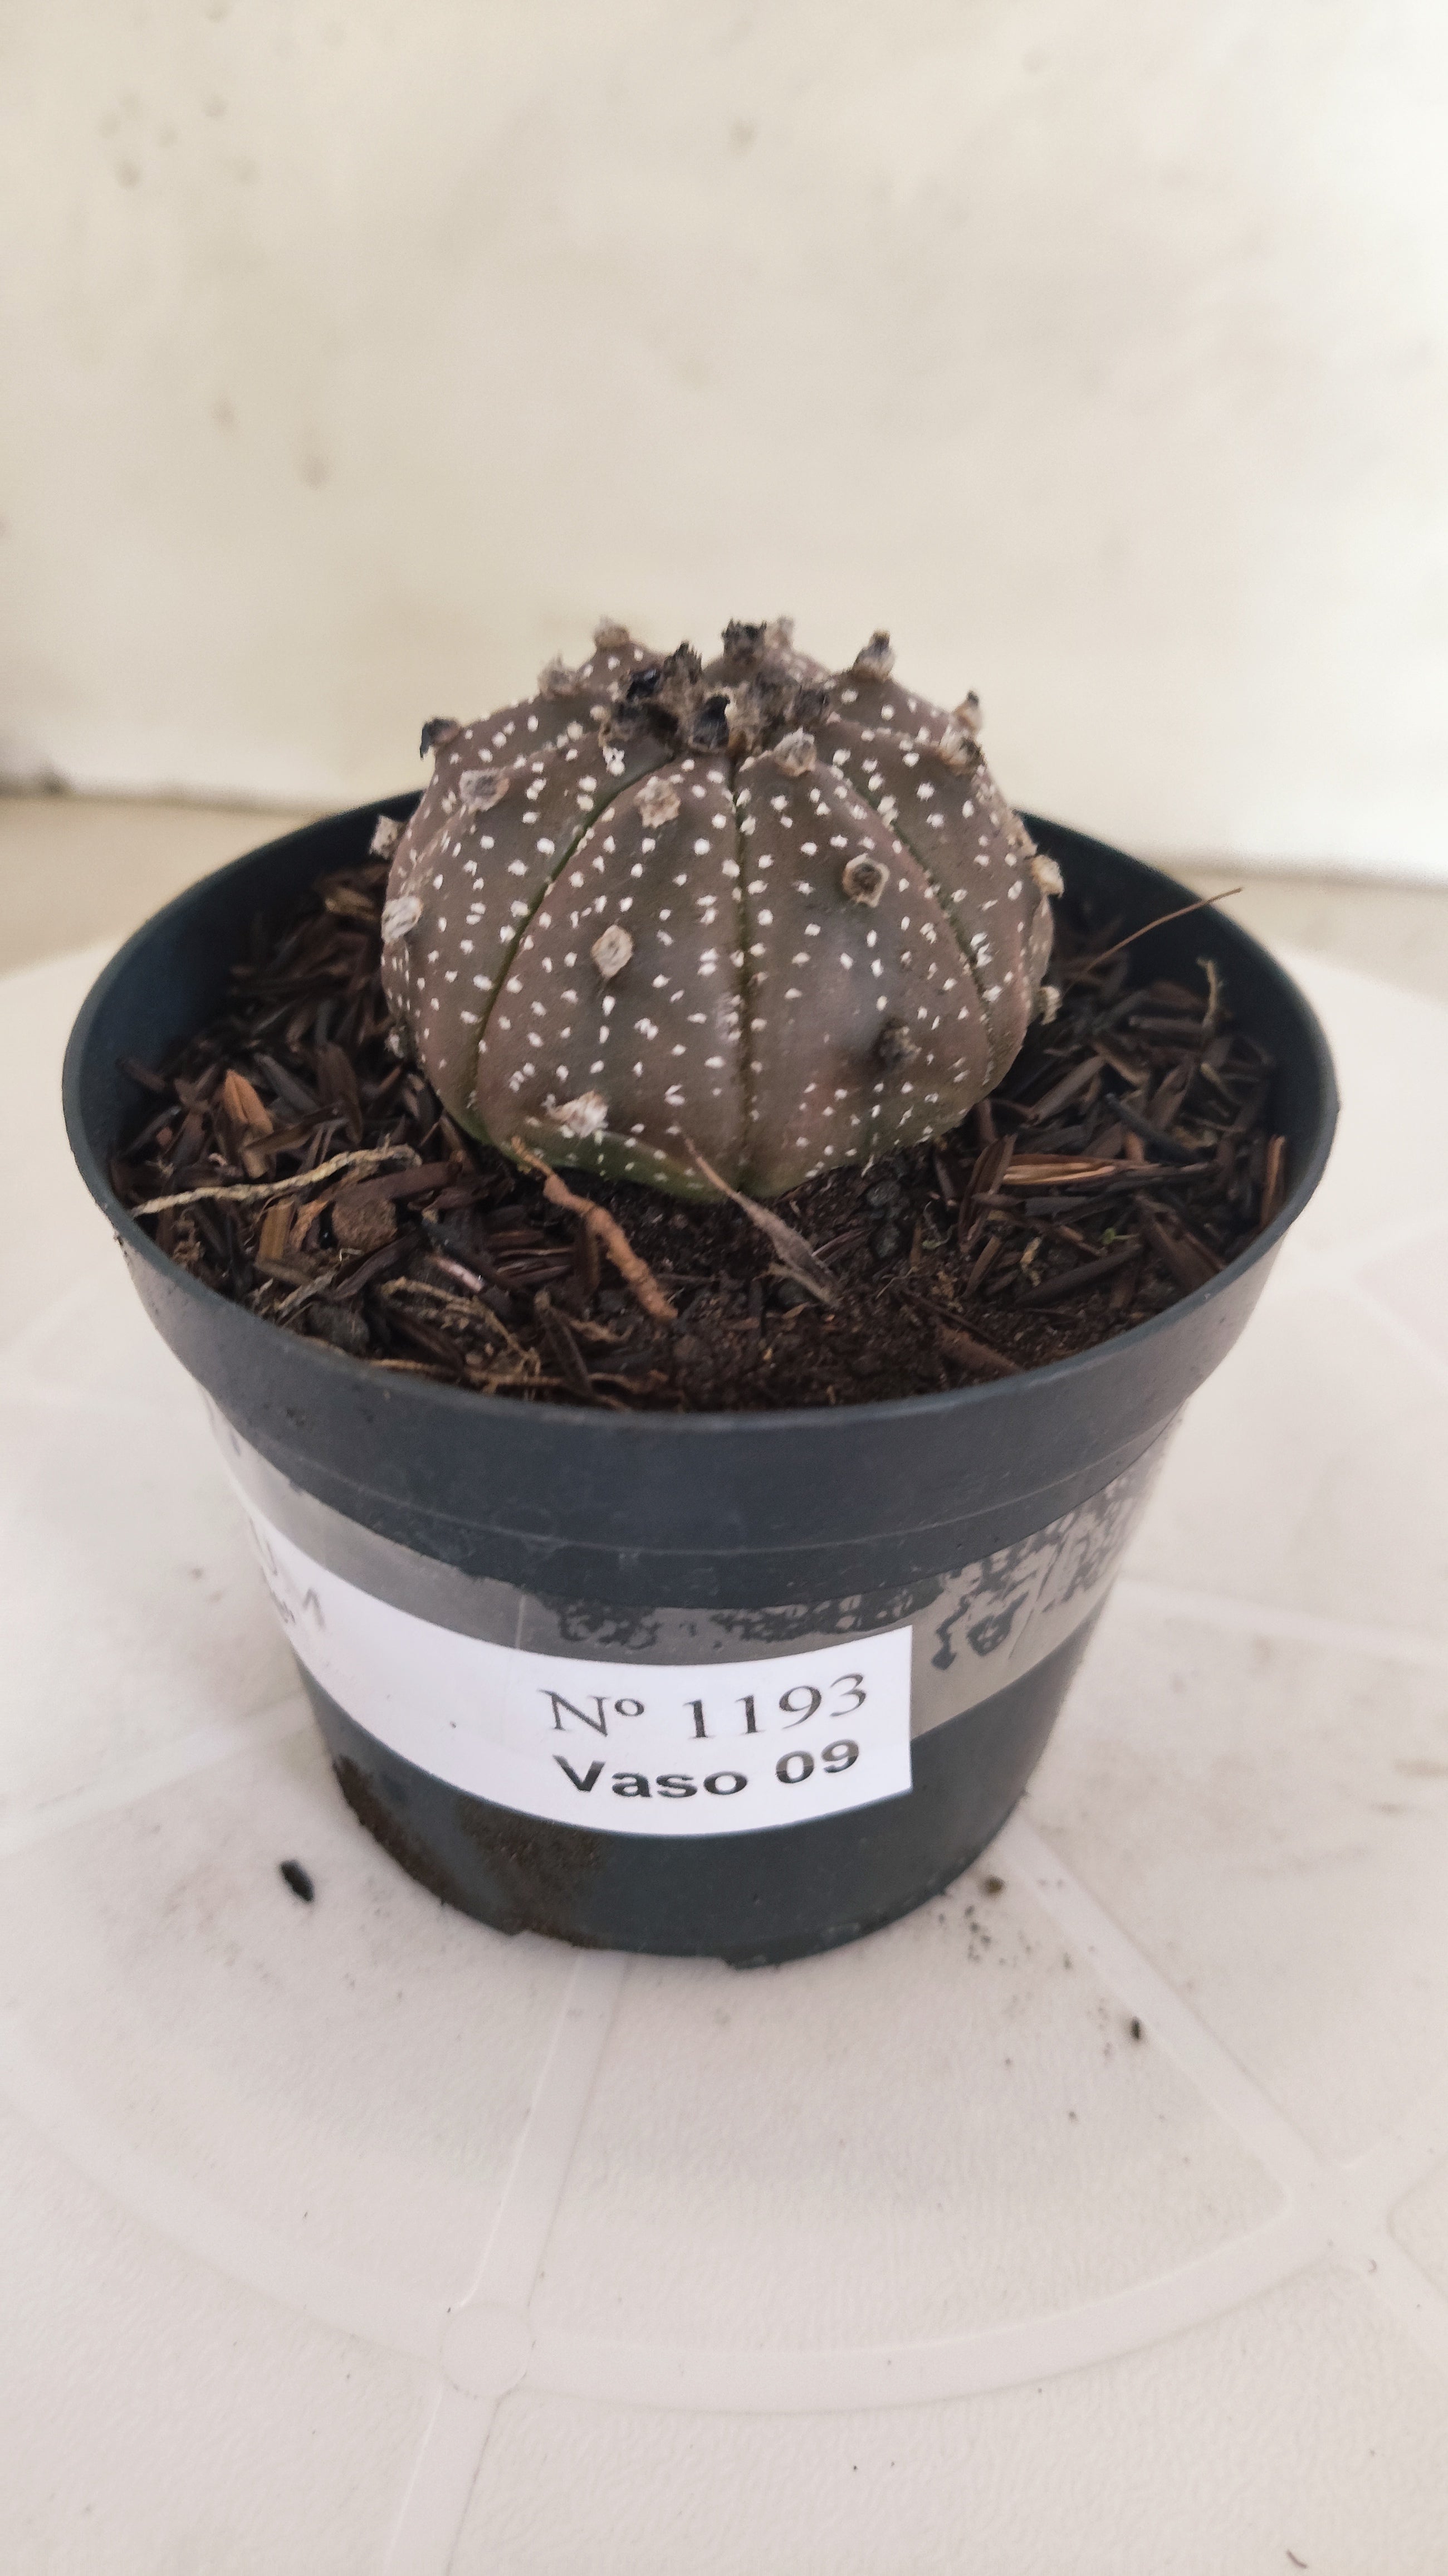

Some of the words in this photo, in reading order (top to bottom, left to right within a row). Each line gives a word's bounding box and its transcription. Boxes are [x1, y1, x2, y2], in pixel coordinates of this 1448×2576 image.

[683, 1672, 867, 1739] 1193
[552, 1754, 748, 1798] Vaso
[776, 1739, 860, 1784] 09
